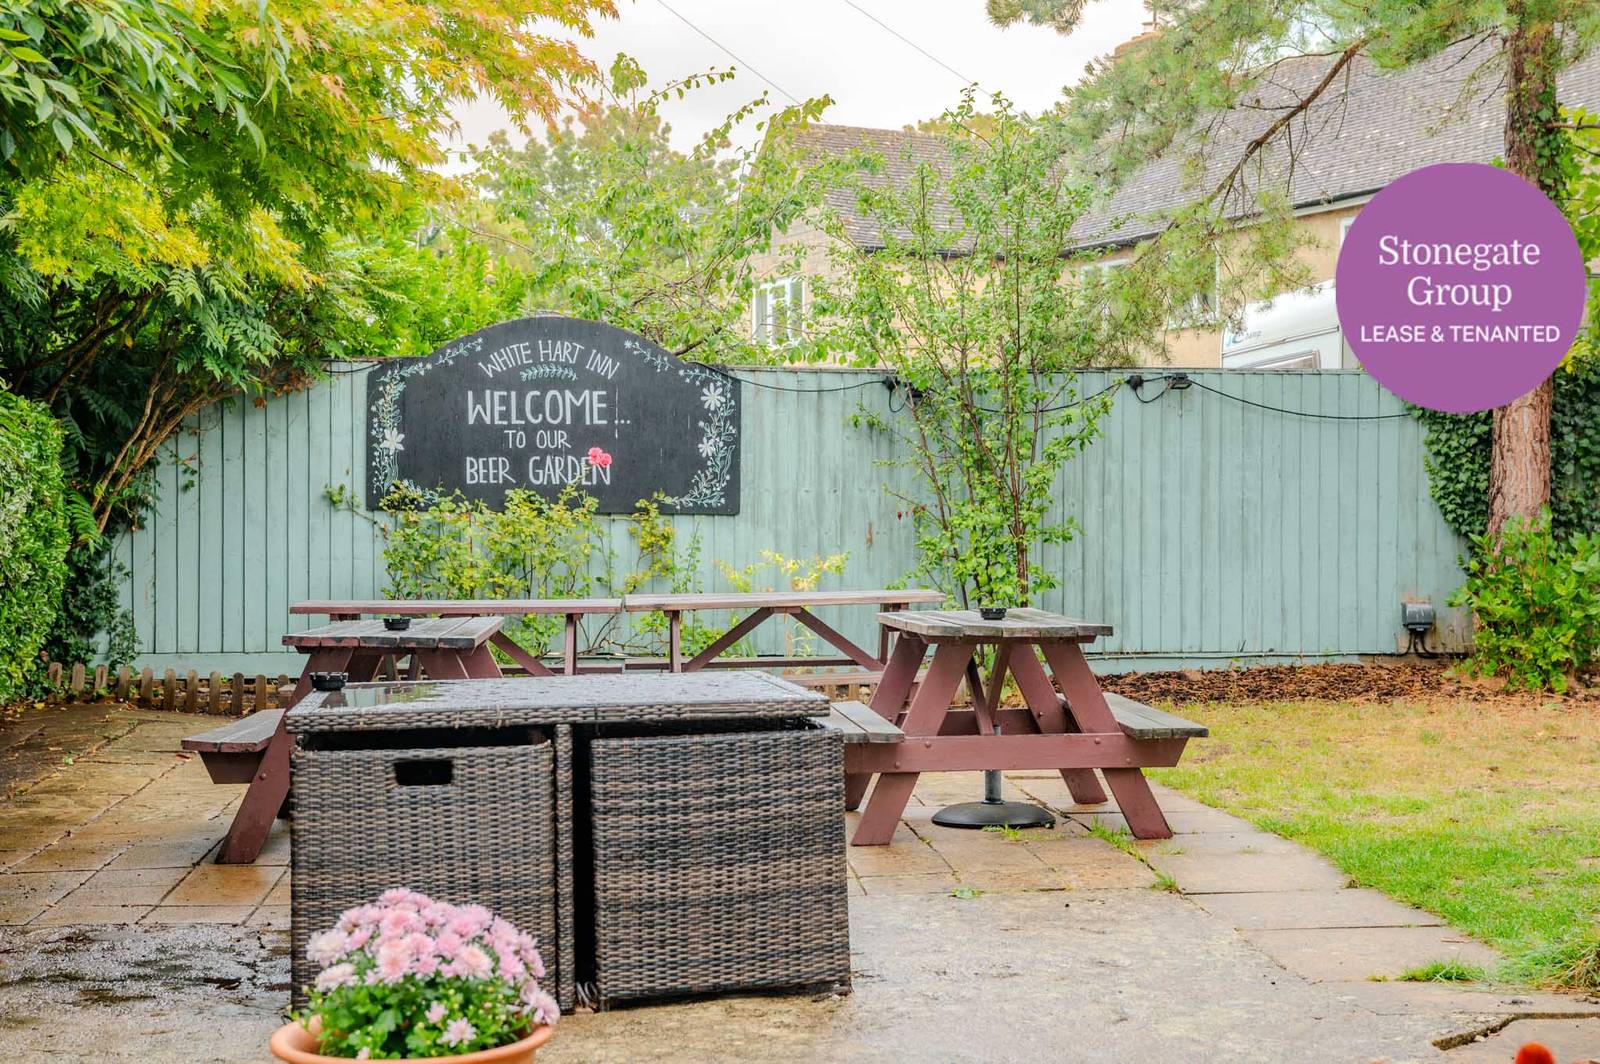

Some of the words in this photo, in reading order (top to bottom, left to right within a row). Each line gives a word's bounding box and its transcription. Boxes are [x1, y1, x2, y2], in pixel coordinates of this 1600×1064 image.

[478, 342, 533, 378] WHITE
[538, 340, 585, 363] HART
[585, 349, 620, 380] INN
[504, 430, 526, 448] TO
[536, 430, 571, 448] OUR
[466, 456, 516, 484] BEER
[528, 456, 611, 485] GARDEN
